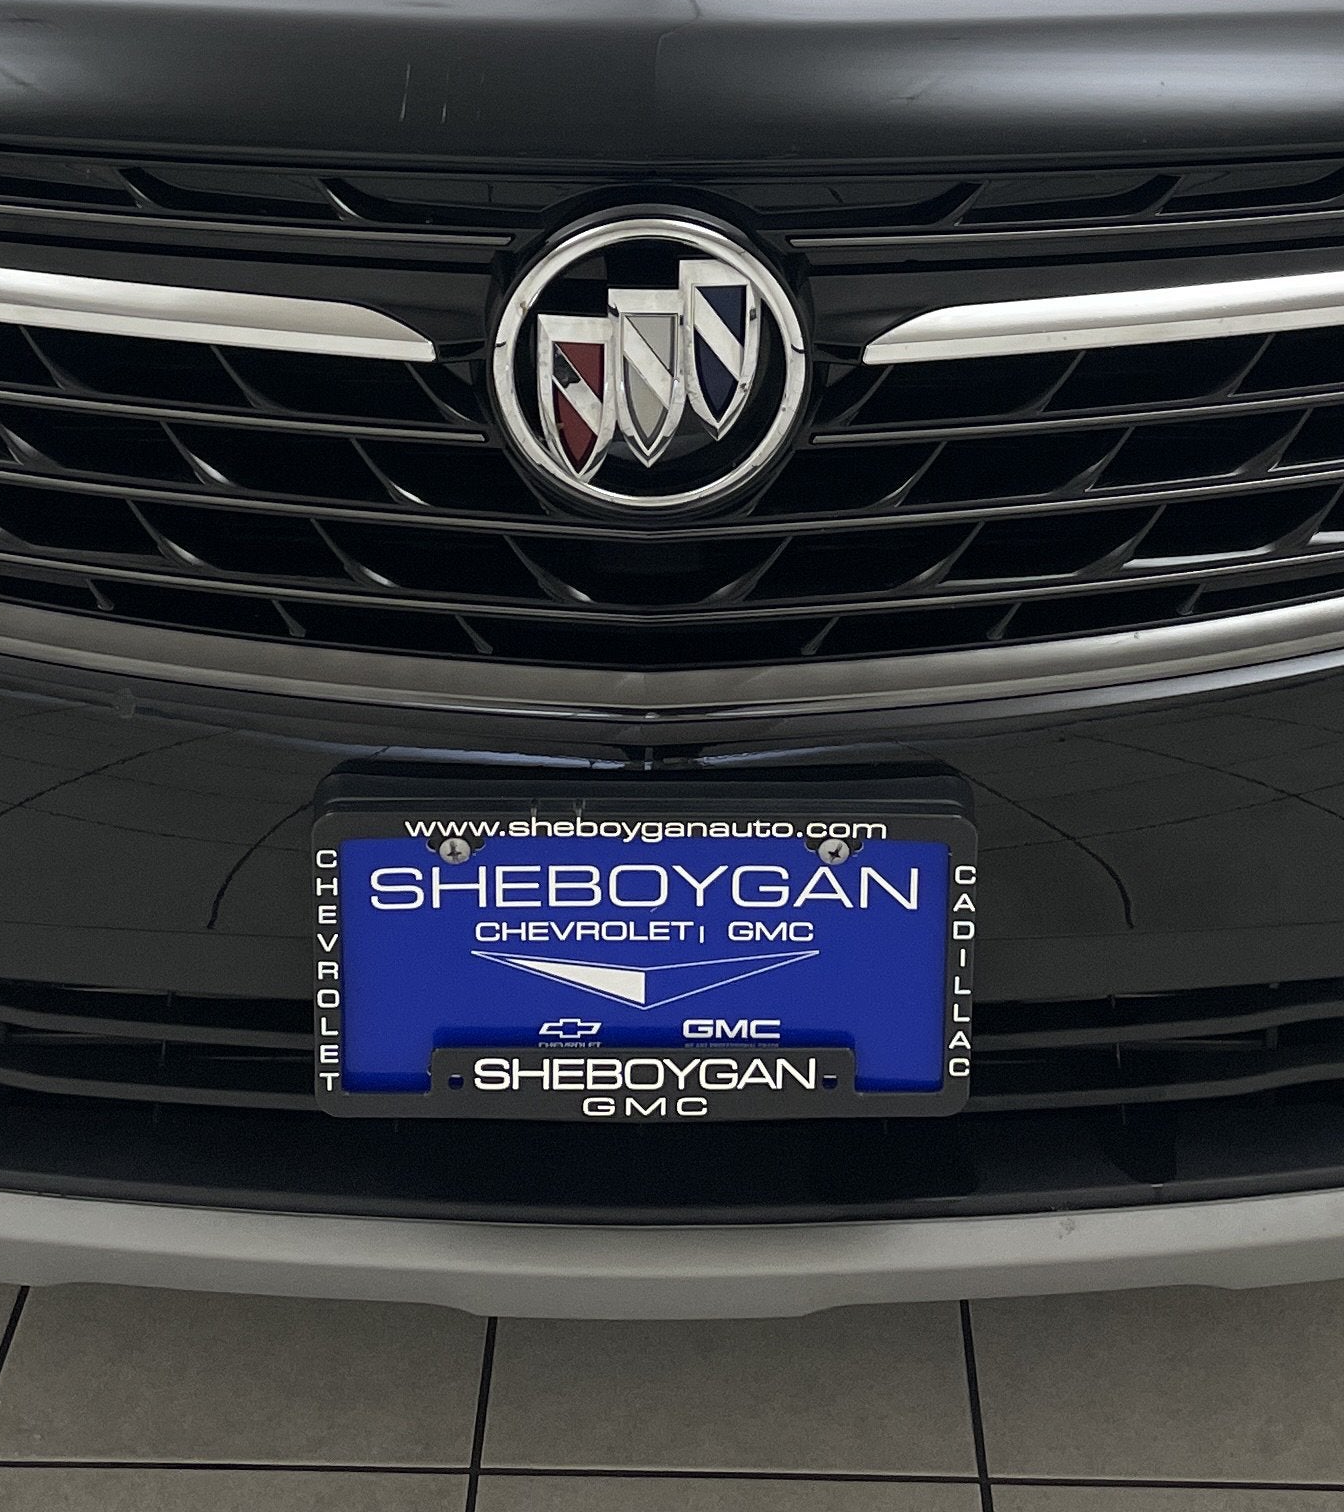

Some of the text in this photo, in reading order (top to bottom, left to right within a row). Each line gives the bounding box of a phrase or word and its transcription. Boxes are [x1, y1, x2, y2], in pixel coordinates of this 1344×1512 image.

[404, 816, 888, 842] www.sheboyganauto.com
[369, 864, 920, 911] SHEBOYGAN
[475, 921, 695, 942] CHEVROLET
[728, 921, 814, 942] GMC
[315, 849, 341, 1092] CHEVROLET
[948, 865, 977, 1078] CADILLAC
[682, 1019, 781, 1039] GMC
[474, 1057, 816, 1091] SHEBOYGAN
[582, 1097, 708, 1117] GMC
